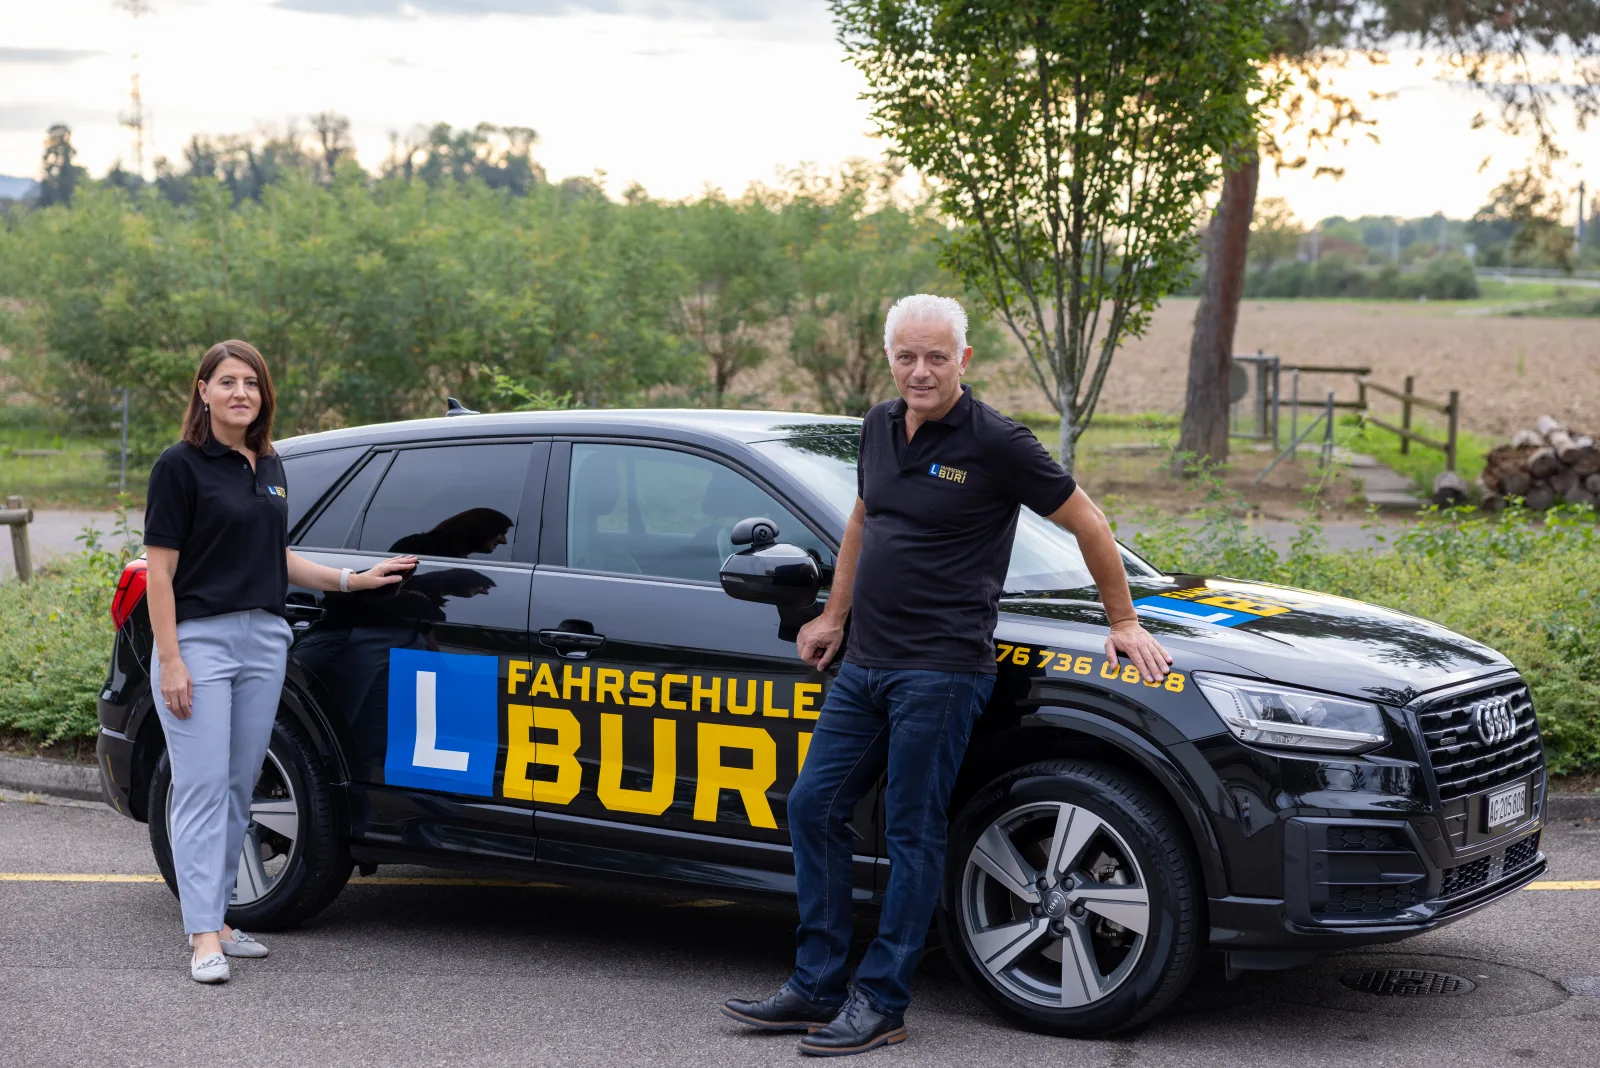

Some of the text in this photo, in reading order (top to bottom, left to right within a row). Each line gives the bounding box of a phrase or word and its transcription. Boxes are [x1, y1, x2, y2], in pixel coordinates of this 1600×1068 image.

[930, 464, 937, 475] L
[938, 469, 966, 484] BURI
[507, 659, 822, 720] FAHRSCHULE
[1036, 649, 1093, 675] 736
[1100, 661, 1186, 693] 088
[412, 670, 470, 772] L
[503, 703, 814, 830] BUR
